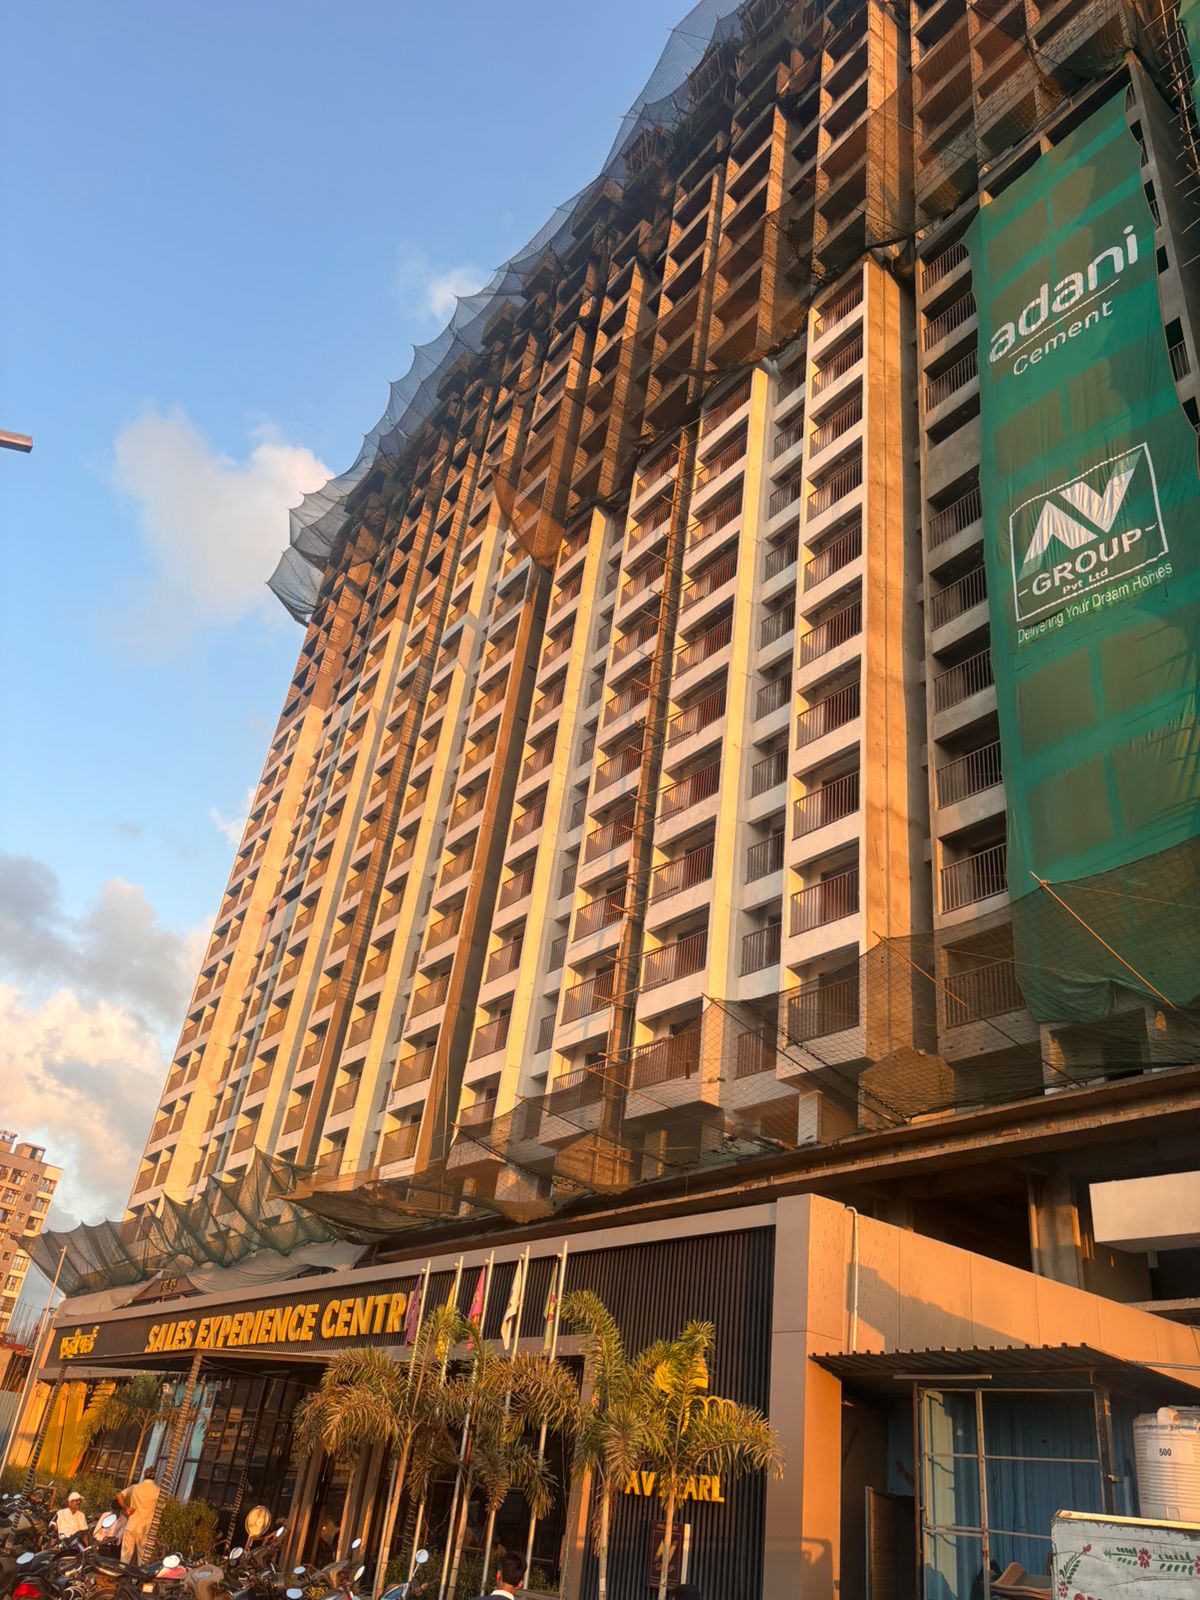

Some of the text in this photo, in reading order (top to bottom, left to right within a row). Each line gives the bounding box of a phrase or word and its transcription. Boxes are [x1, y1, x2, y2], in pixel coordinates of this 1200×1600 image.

[990, 225, 1138, 363] adani
[1013, 300, 1113, 375] Cement
[1031, 528, 1143, 596] GROUP
[1062, 567, 1109, 595] Pvt Ltd
[1017, 562, 1173, 644] Delivering Your Dream Homes
[144, 1319, 197, 1353] SALES
[194, 1303, 319, 1349] EXPERIENCE
[1159, 1447, 1172, 1457] 500
[624, 1470, 656, 1497] AV
